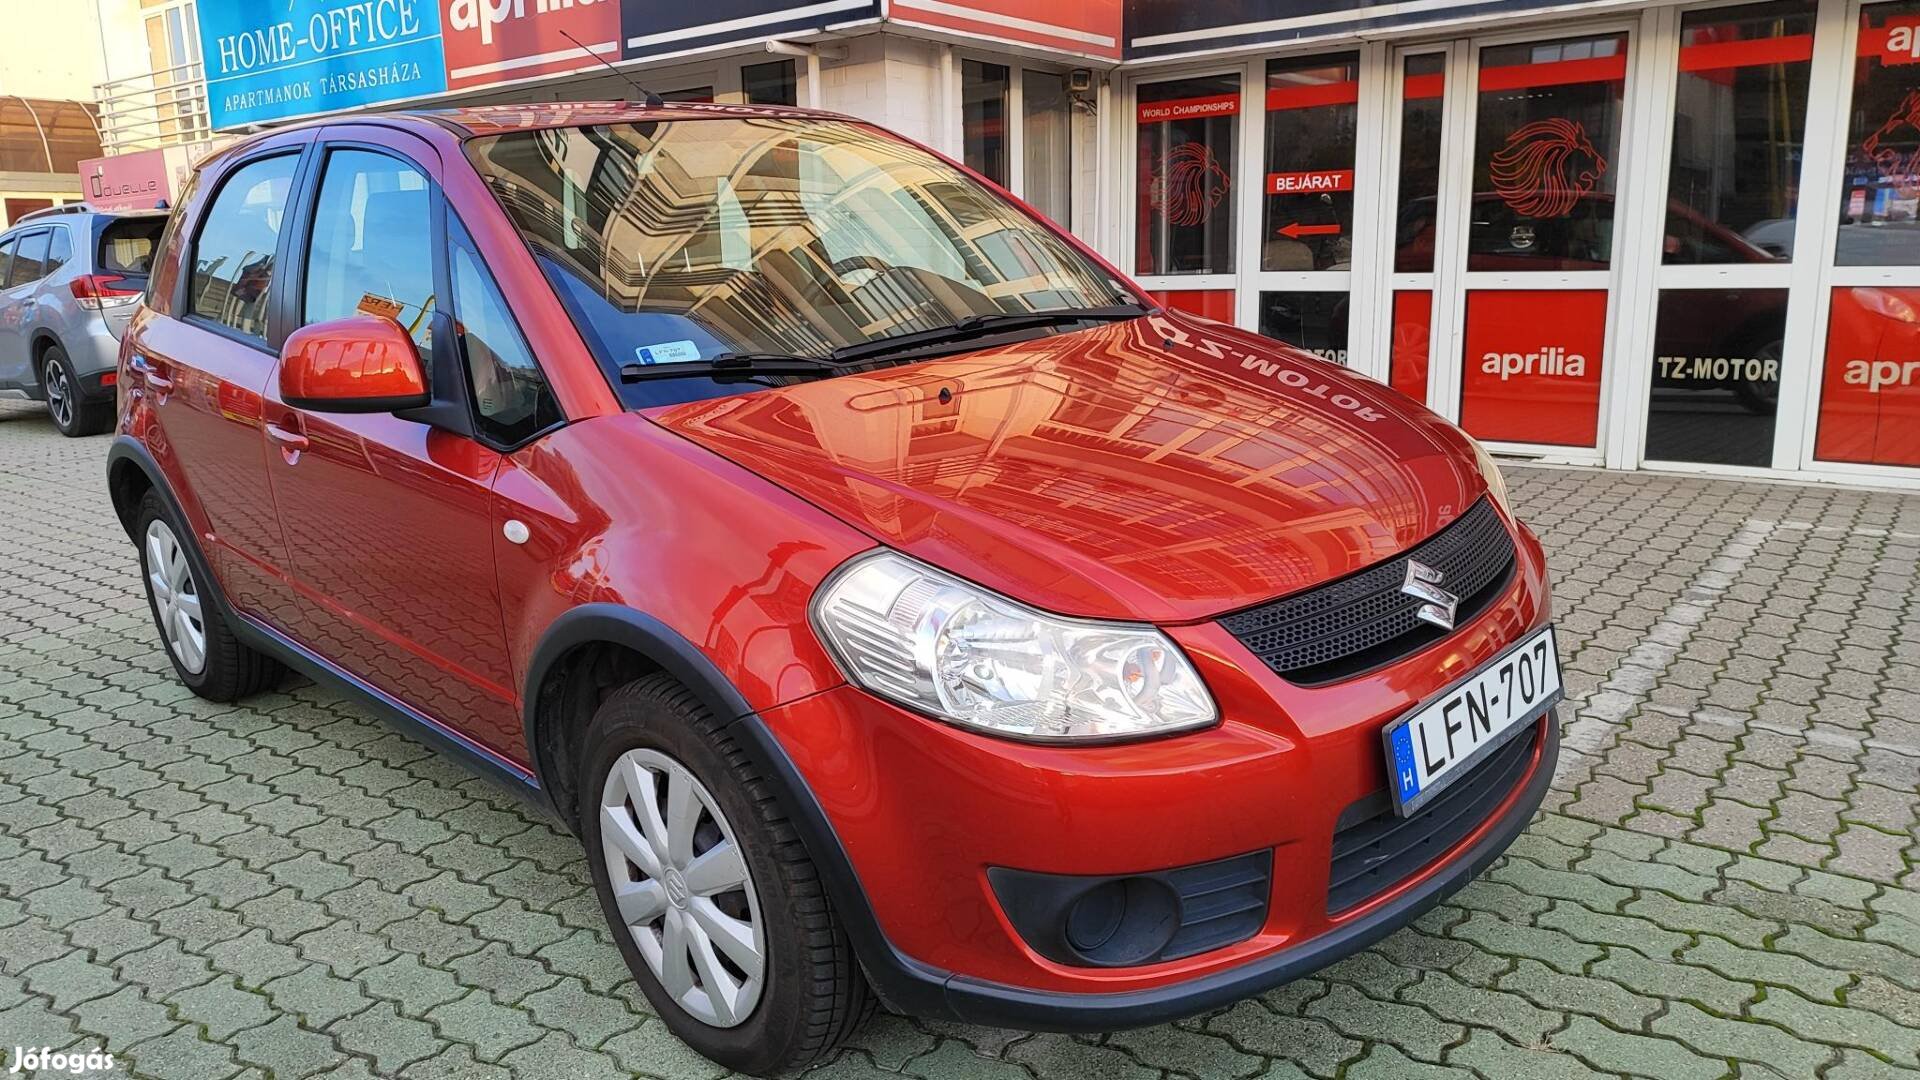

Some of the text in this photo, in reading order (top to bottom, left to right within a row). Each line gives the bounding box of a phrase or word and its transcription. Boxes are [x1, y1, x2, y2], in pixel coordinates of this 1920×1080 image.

[218, 0, 420, 73] HOME-OFFICE
[225, 62, 421, 112] APARTMANOK TÁRSASHÁZA
[1142, 101, 1235, 118] WORLD CHAMPIONSHIPS
[1276, 173, 1342, 191] BEJÁRAT
[1481, 347, 1585, 381] aprilia
[1658, 356, 1778, 382] TZ-MOTOR
[1843, 360, 1920, 393] apr
[1402, 639, 1547, 791] H LFN-707
